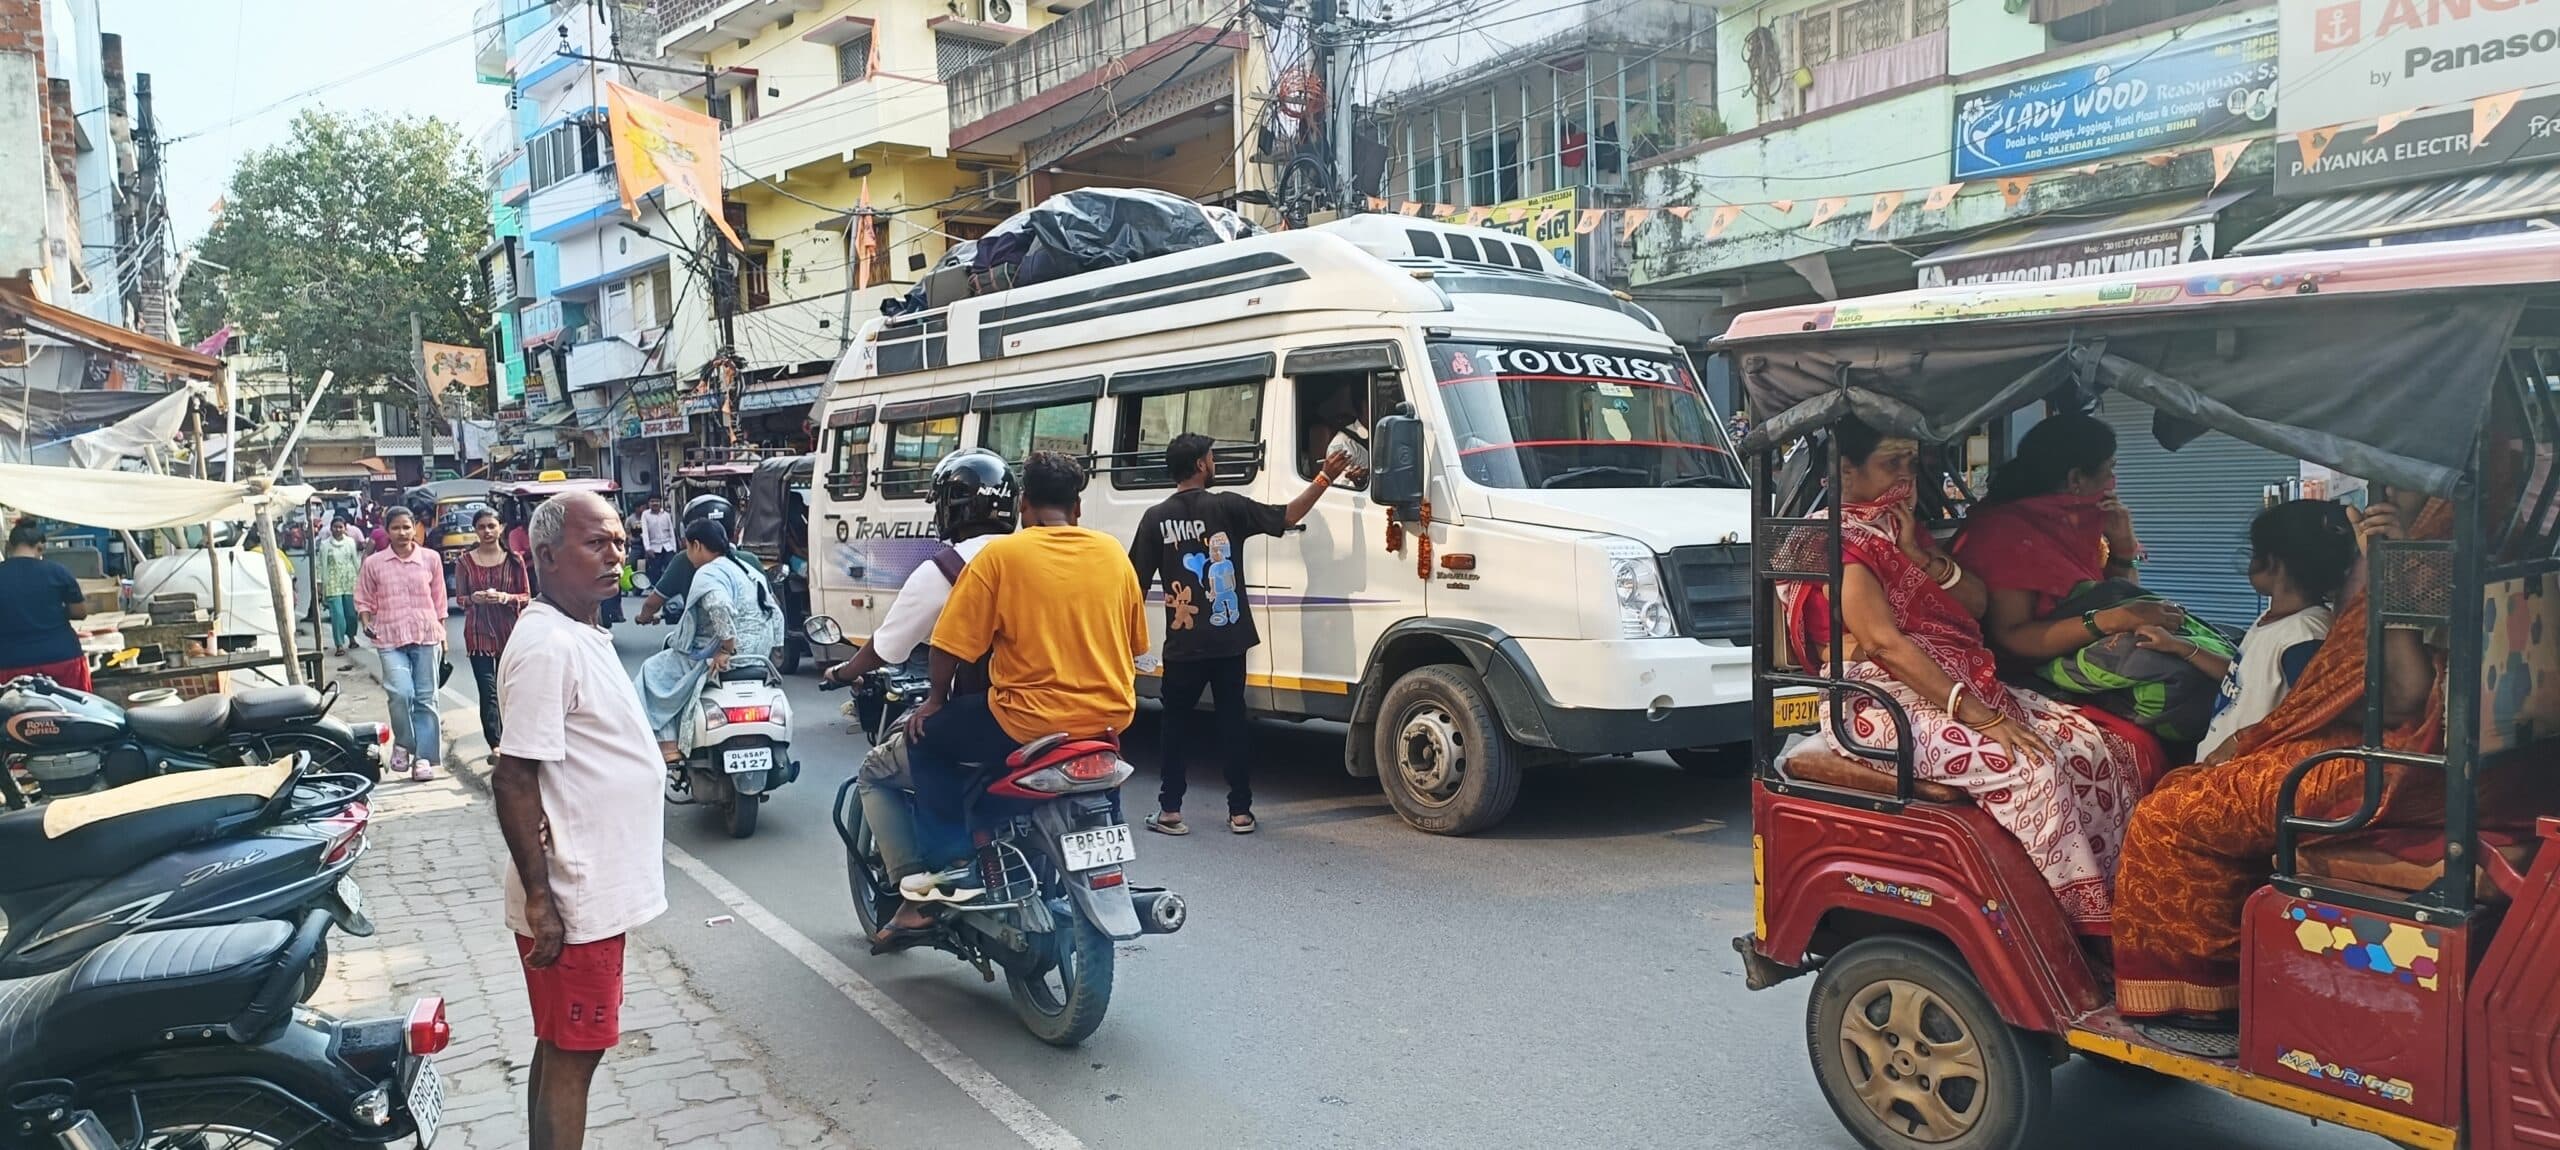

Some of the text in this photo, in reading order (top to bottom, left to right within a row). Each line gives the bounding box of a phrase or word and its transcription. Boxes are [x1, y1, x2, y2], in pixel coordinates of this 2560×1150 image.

[2370, 26, 2560, 87] by Panaso
[2004, 79, 2148, 134] LADY WOOD
[2005, 136, 2026, 149] Deals
[2095, 132, 2134, 147] ASHRAM
[2166, 118, 2197, 132] BIHAR
[2291, 148, 2388, 177] PIYANKA
[1476, 348, 1677, 385] TOURIST
[856, 516, 939, 540] TRAVELLE
[26, 719, 56, 728] ROYAL
[729, 758, 768, 770] 4127
[2280, 1052, 2364, 1085] MAYURI
